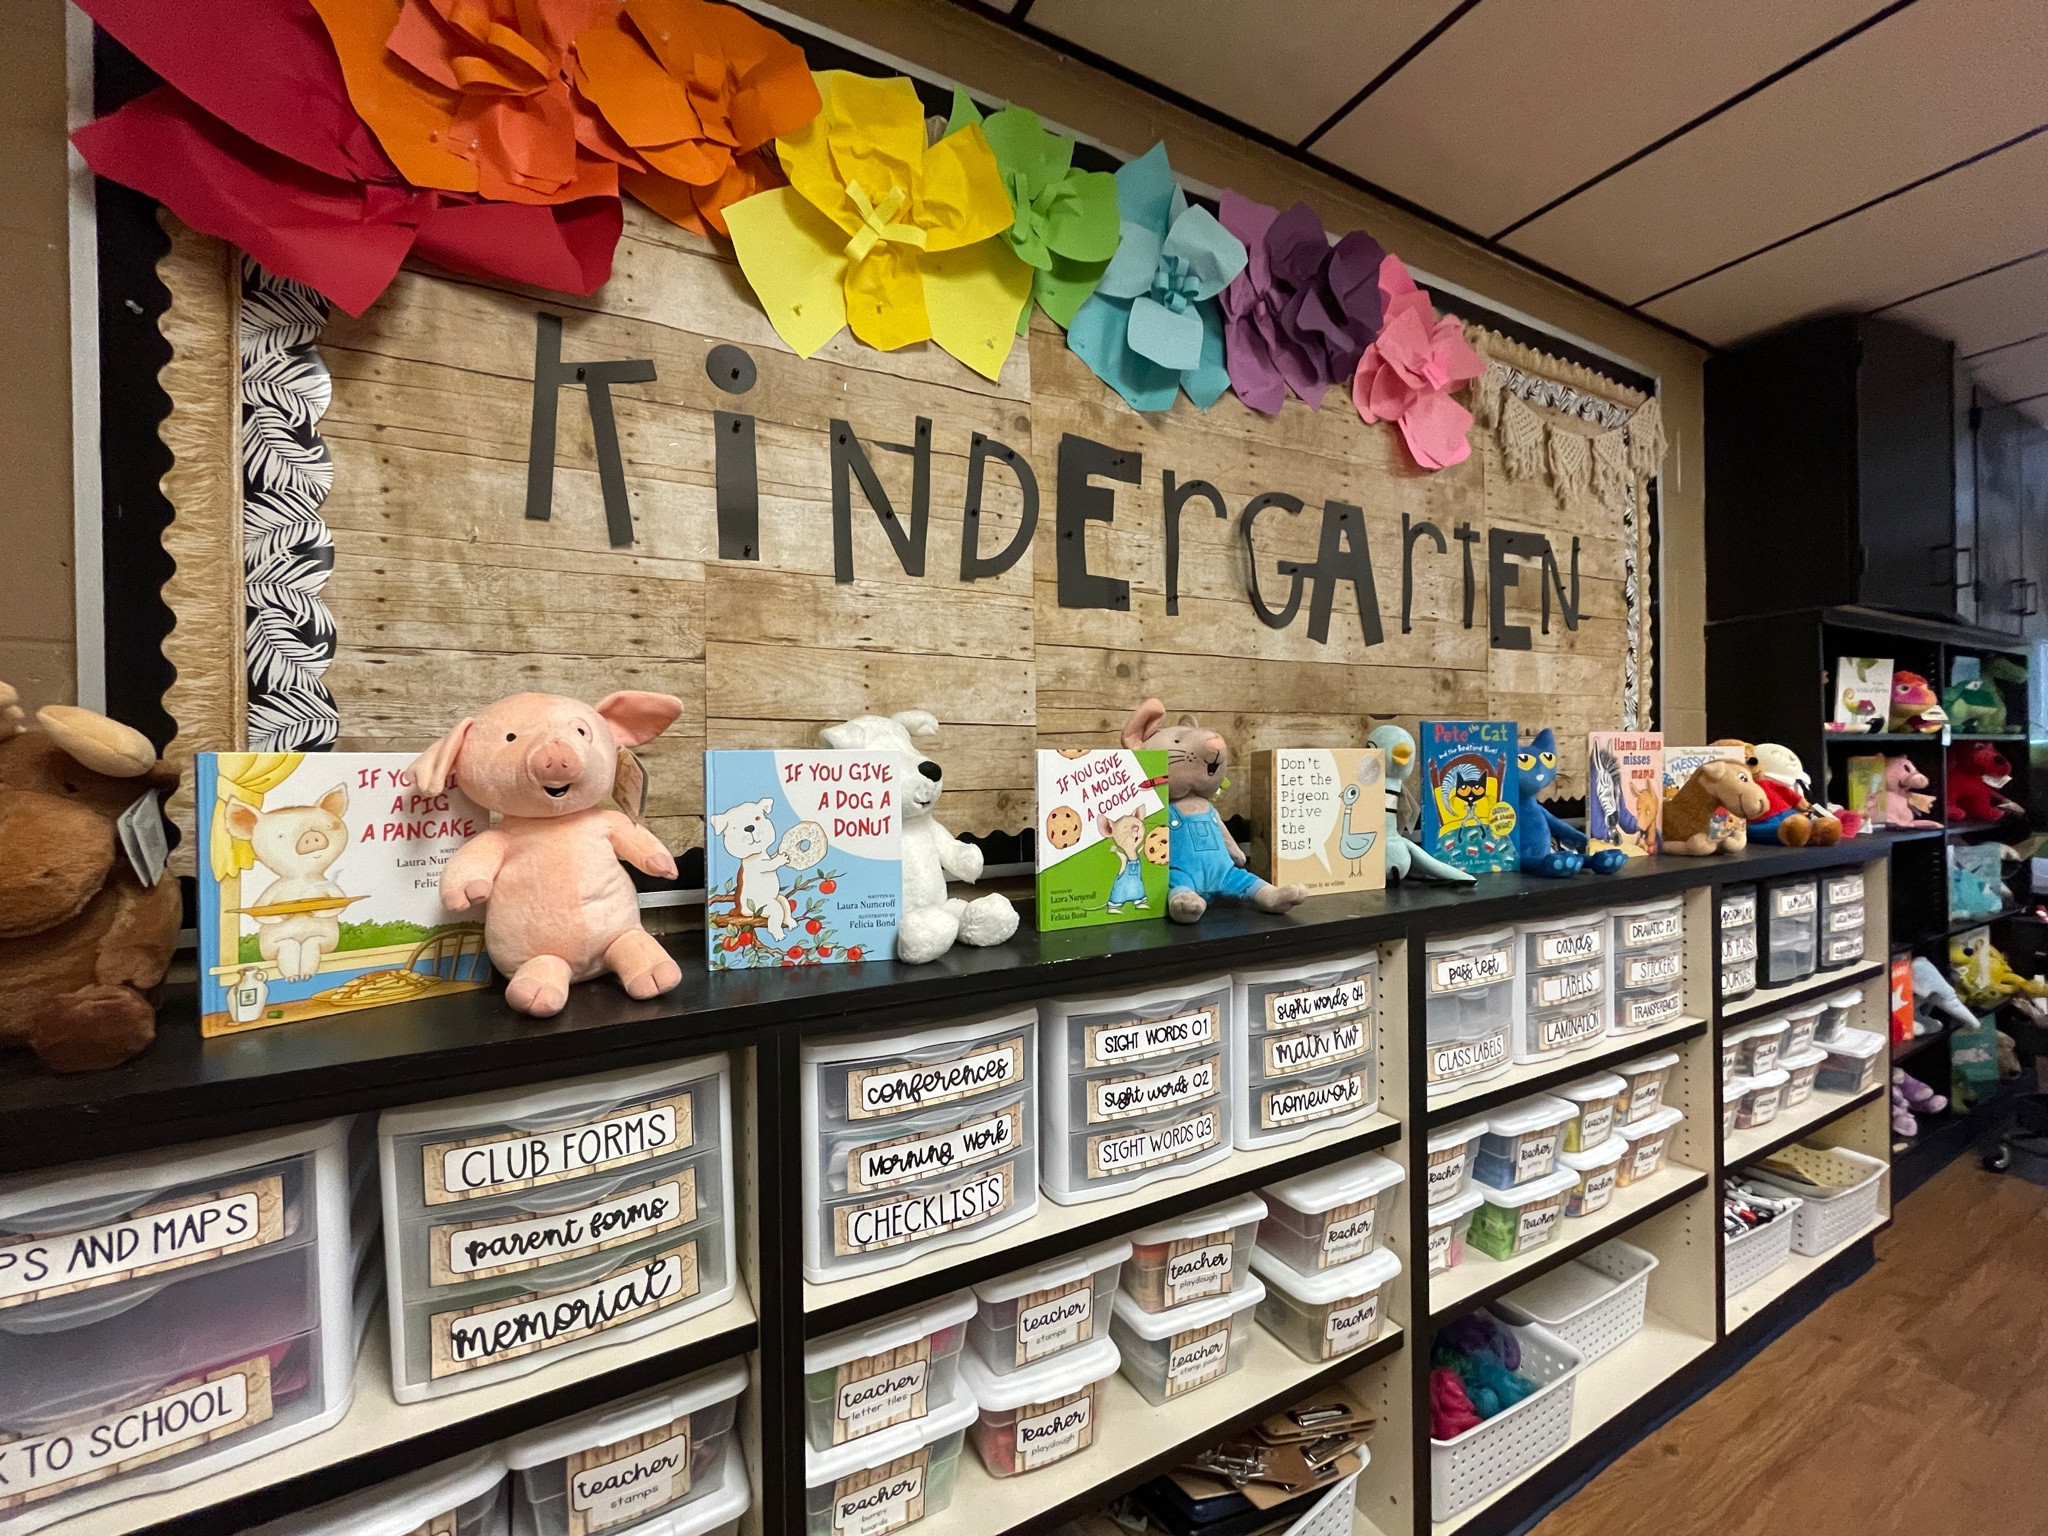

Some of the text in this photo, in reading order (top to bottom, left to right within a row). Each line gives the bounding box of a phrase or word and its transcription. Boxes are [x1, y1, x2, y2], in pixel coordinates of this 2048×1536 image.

[1434, 722, 1468, 743] Pete
[1481, 724, 1508, 741] Cat
[1614, 737, 1661, 751] llama llama
[785, 762, 893, 783] IF YOU GIVE
[1281, 758, 1320, 770] Don't
[1623, 753, 1650, 765] misses
[358, 768, 381, 789] IF
[1056, 753, 1122, 795] IF YOU GIVE
[1082, 769, 1131, 803] A MOUSE
[1281, 773, 1331, 786] Let the
[1631, 769, 1654, 779] mama
[390, 793, 449, 815] A PIG
[818, 790, 891, 811] A DOG A
[1087, 783, 1139, 821] A COOKIE
[1282, 789, 1329, 804] Pigeon
[1281, 805, 1322, 818] Drive
[360, 818, 477, 843] A PANCAKE
[834, 815, 891, 837] DONUT
[1282, 822, 1305, 834] the
[1281, 838, 1311, 850] Bus!
[397, 858, 426, 867] Laura
[414, 879, 438, 889] Felic
[837, 899, 896, 910] Laura Numeroff
[850, 918, 896, 929] Felicia Bond
[1556, 934, 1592, 955] cards
[1449, 955, 1499, 985] pass test
[1640, 957, 1676, 979] STICKERS
[1560, 971, 1593, 999] LABELS
[1277, 997, 1311, 1020] sight
[1314, 988, 1349, 1011] words
[1104, 1031, 1139, 1053] SIGHT
[1146, 1023, 1188, 1046] WORDS
[1547, 1012, 1599, 1042] LAMINATION
[1276, 1025, 1359, 1064] math hw
[1438, 1037, 1502, 1071] CLASS LABELS
[867, 1058, 1009, 1104] conferences
[1104, 1070, 1209, 1110] sight words 02
[1270, 1078, 1359, 1116] homework
[461, 1113, 667, 1188] CLUB FORMS
[869, 1119, 1008, 1177] Morning Work
[1103, 1136, 1146, 1163] SIGHT
[1150, 1123, 1193, 1152] WORDS
[854, 1177, 1000, 1245] CHECKLISTS
[67, 1227, 140, 1274] AND
[153, 1203, 249, 1254] MAPS
[465, 1197, 669, 1267] parent forms
[1171, 1251, 1229, 1280] teacher
[1180, 1272, 1218, 1289] playdough
[451, 1258, 672, 1359] memorial
[1023, 1302, 1086, 1333] teacher
[1331, 1306, 1376, 1331] Teacher
[1036, 1328, 1067, 1345] stamps
[1171, 1342, 1223, 1371] teacher
[843, 1375, 920, 1408] teacher
[852, 1393, 908, 1421] letter tiles
[22, 1436, 74, 1479] TO
[89, 1385, 232, 1459] SCHOOL
[1021, 1410, 1086, 1443] Teacher
[1031, 1432, 1076, 1457] playdough
[577, 1451, 680, 1499] teacher
[610, 1484, 659, 1510] stamps
[841, 1479, 917, 1519] Teacher
